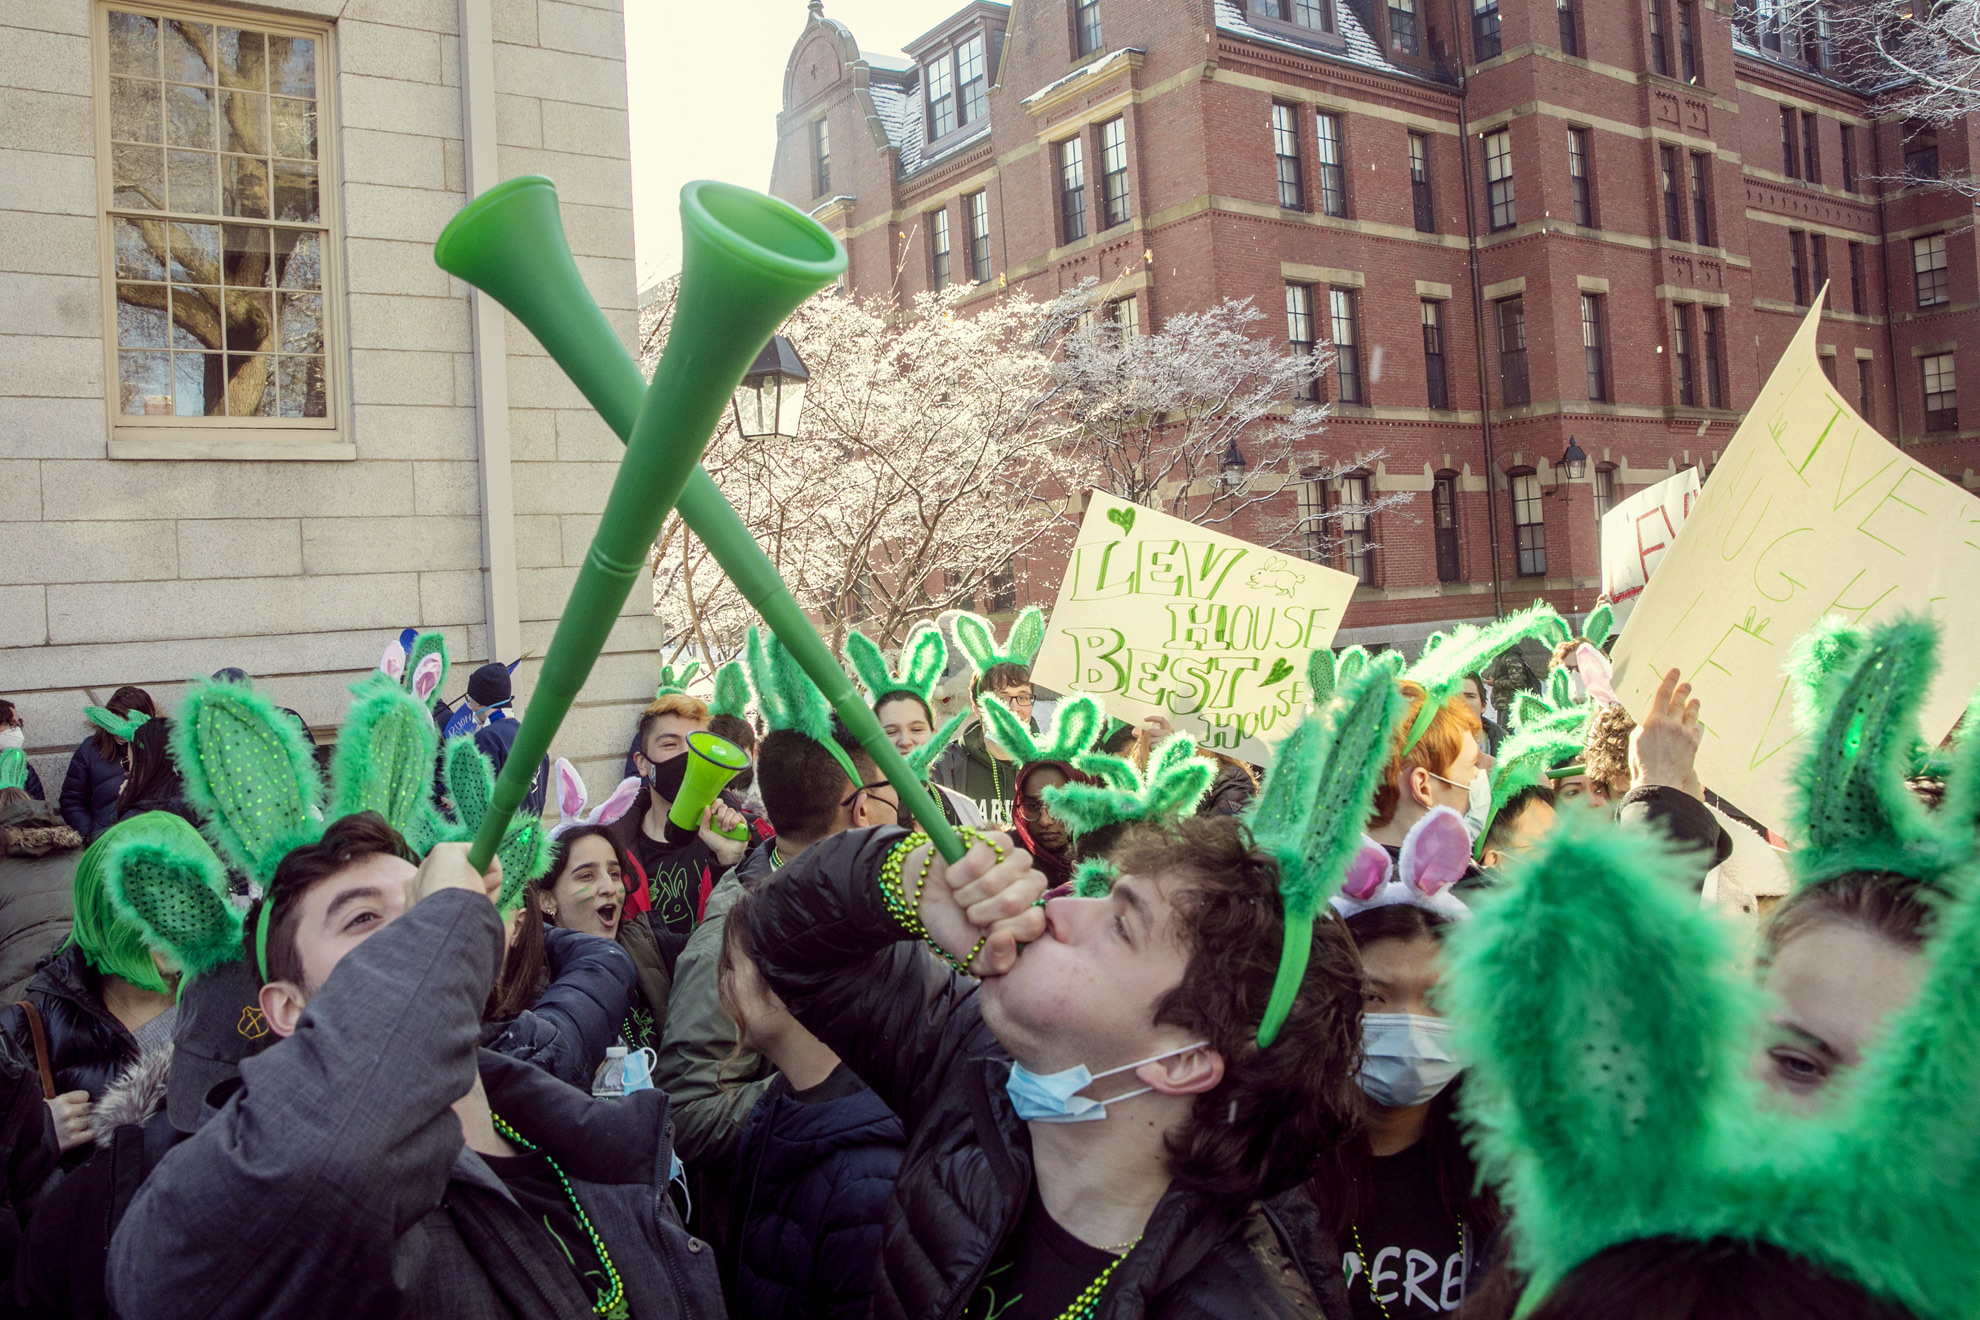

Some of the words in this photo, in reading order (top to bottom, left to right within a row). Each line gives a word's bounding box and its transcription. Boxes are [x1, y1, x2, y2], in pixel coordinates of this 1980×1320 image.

[1070, 539, 1249, 601] LEV
[1162, 602, 1331, 652] HOUSE
[1061, 627, 1260, 715] BEST
[1198, 680, 1305, 750] HOUSE
[972, 798, 1015, 827] ARV
